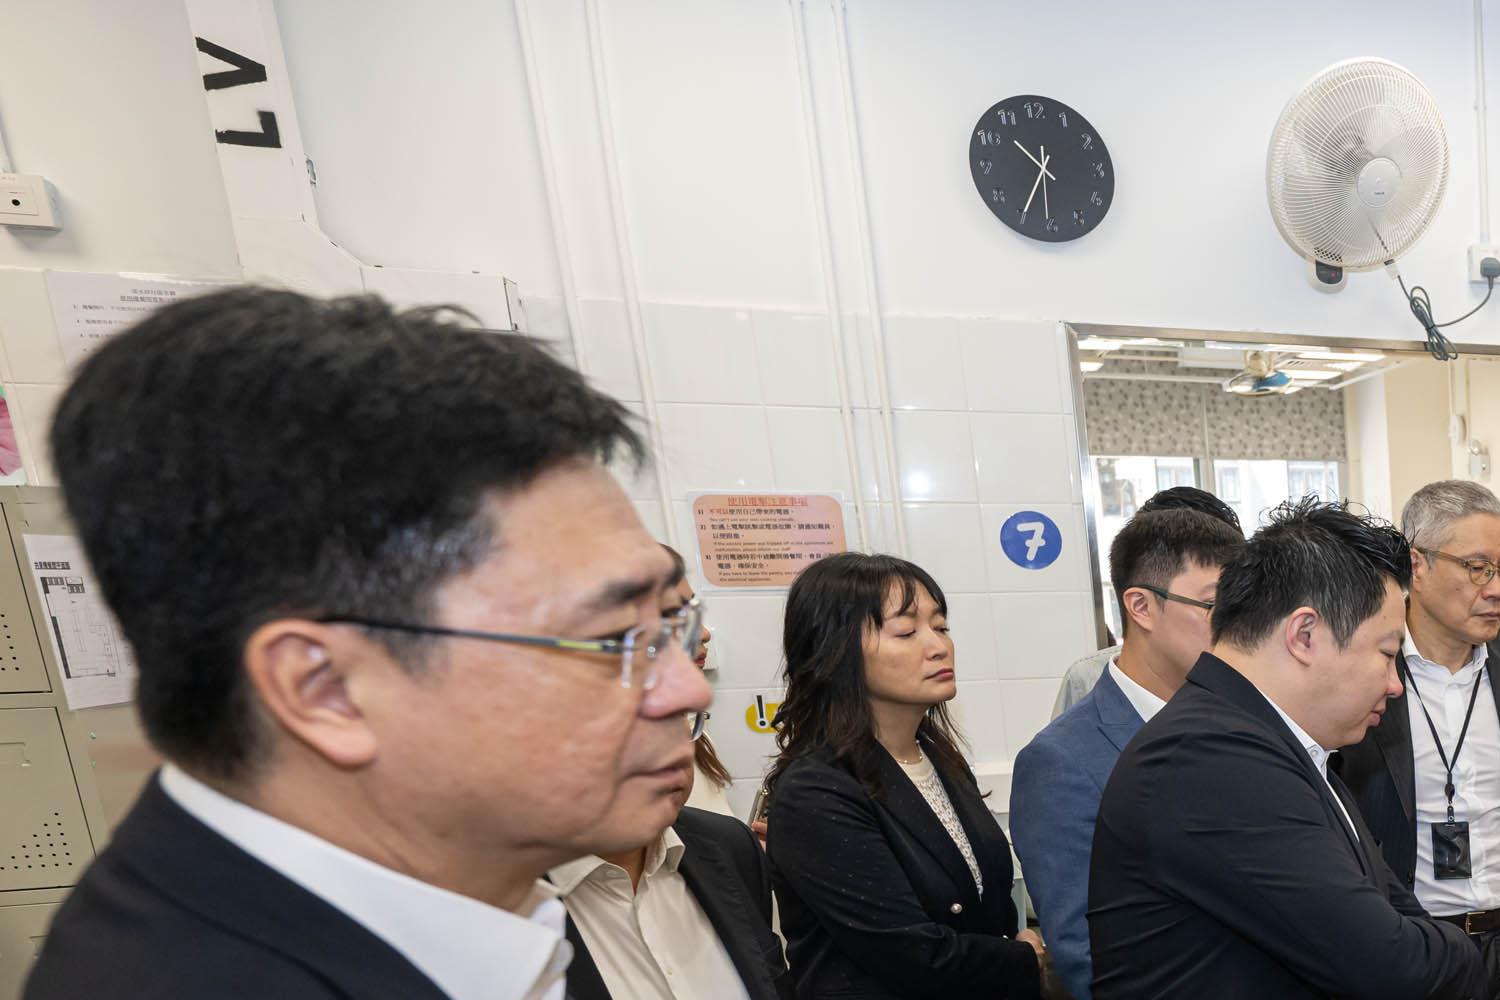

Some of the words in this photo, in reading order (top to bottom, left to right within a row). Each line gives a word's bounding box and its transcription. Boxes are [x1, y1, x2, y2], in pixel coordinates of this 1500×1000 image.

[195, 36, 282, 148] LV
[998, 109, 1016, 126] 11
[1081, 132, 1093, 150] 2
[1017, 521, 1046, 561] 7
